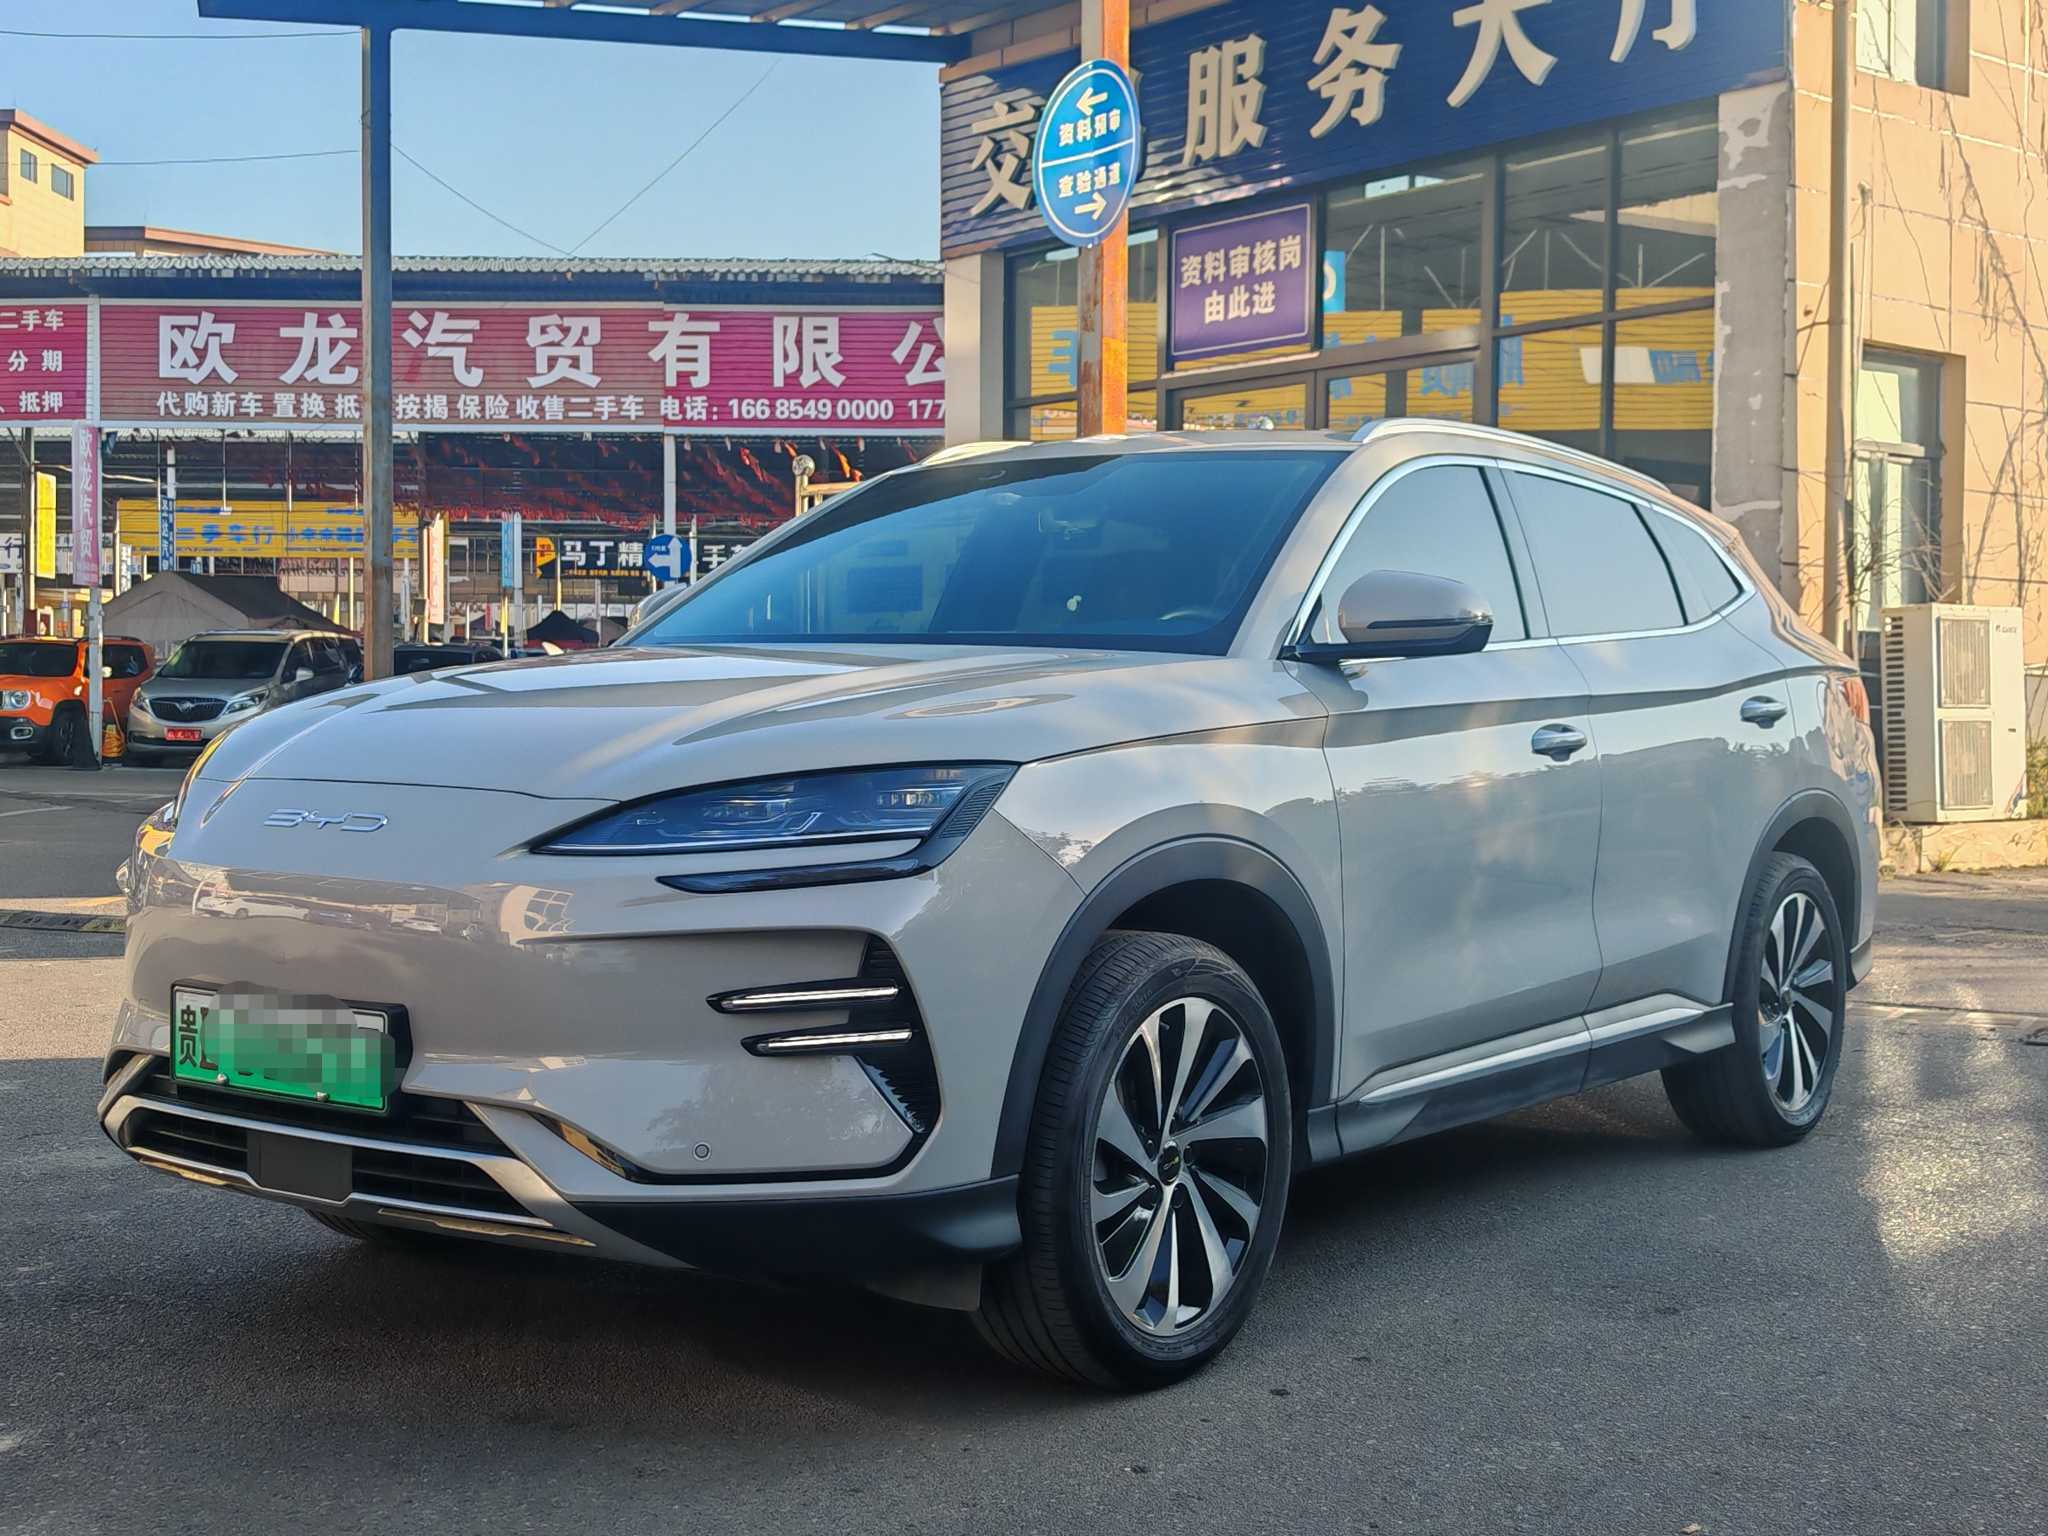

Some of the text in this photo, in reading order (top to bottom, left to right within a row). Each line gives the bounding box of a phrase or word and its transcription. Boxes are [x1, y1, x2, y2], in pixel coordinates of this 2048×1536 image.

[970, 0, 1698, 217] 交服务大
[1059, 108, 1120, 147] 资料预审
[1059, 161, 1120, 198] 查验通道
[1180, 235, 1301, 289] 资料审核岗
[0, 308, 64, 332] 二手车
[1204, 280, 1276, 325] 由此进
[158, 311, 945, 388] 欧龙汽贸有限公
[19, 390, 63, 413] 抵押
[156, 392, 263, 418] 代购新车
[273, 393, 325, 419] 置换
[396, 393, 448, 420] 按揭
[457, 394, 509, 420] 保险
[516, 395, 644, 421] 收售二手车
[729, 399, 770, 420] 166
[775, 399, 832, 420] 8549
[836, 399, 893, 420] 0000
[263, 808, 388, 832] BYD
